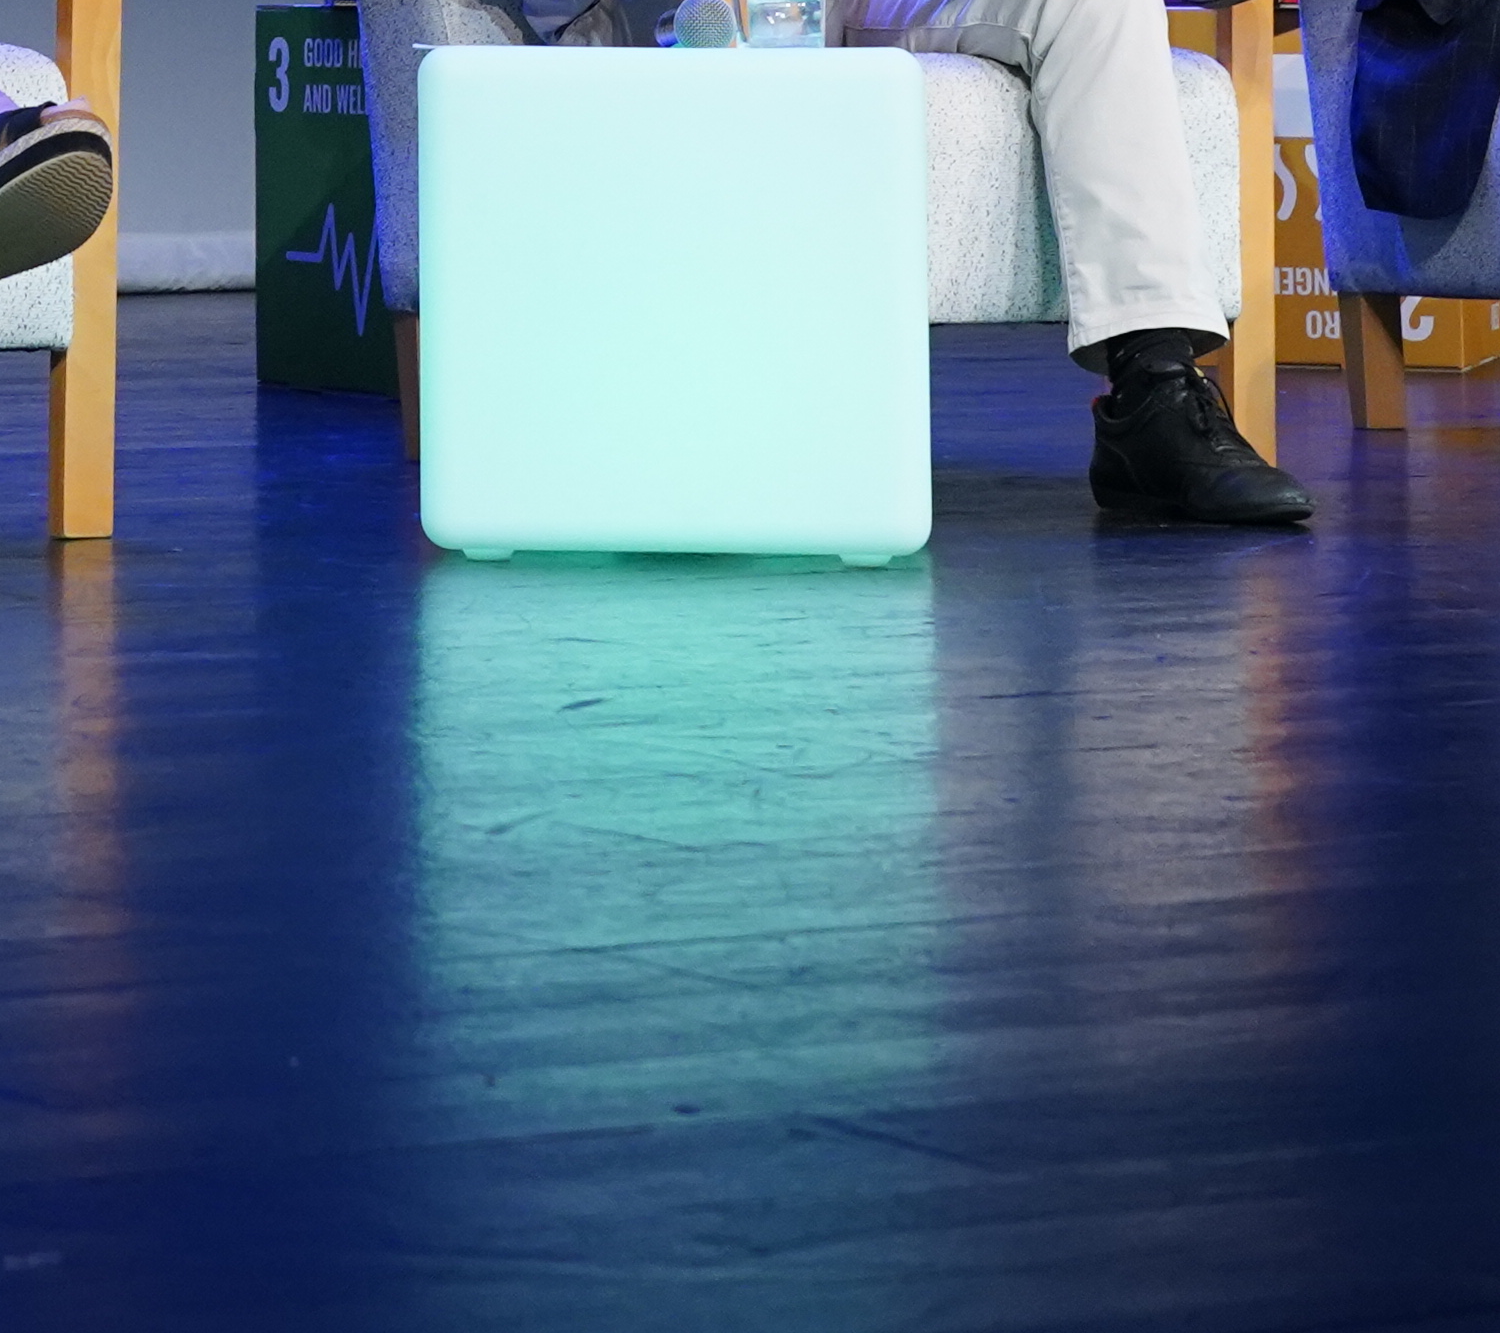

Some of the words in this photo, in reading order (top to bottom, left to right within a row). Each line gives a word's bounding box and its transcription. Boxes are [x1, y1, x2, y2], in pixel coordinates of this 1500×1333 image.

[268, 36, 291, 113] 3
[303, 37, 344, 69] GOOD
[302, 83, 332, 114] AND
